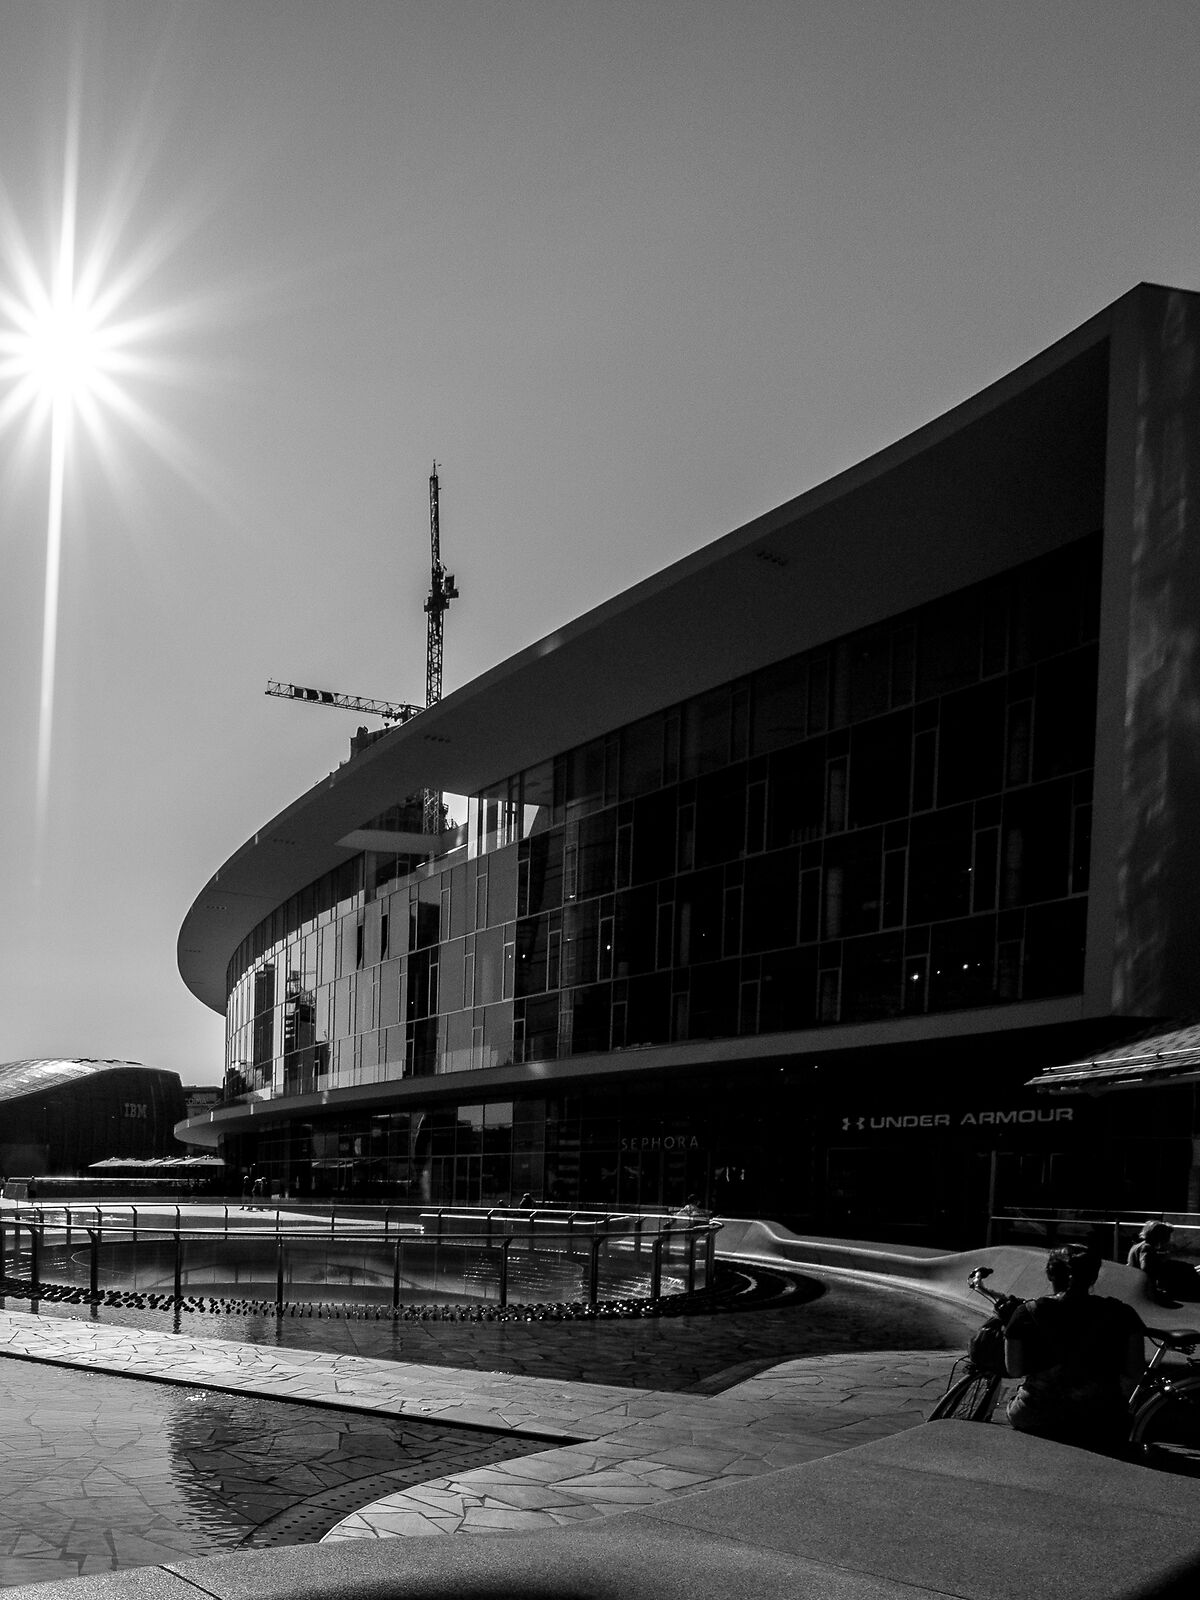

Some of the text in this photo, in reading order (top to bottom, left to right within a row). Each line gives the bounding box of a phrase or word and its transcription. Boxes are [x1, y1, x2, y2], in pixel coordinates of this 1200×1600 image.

[124, 1103, 147, 1118] IBM
[869, 1107, 1075, 1128] UNDER ARMOUR
[620, 1136, 699, 1151] SEPHORA
